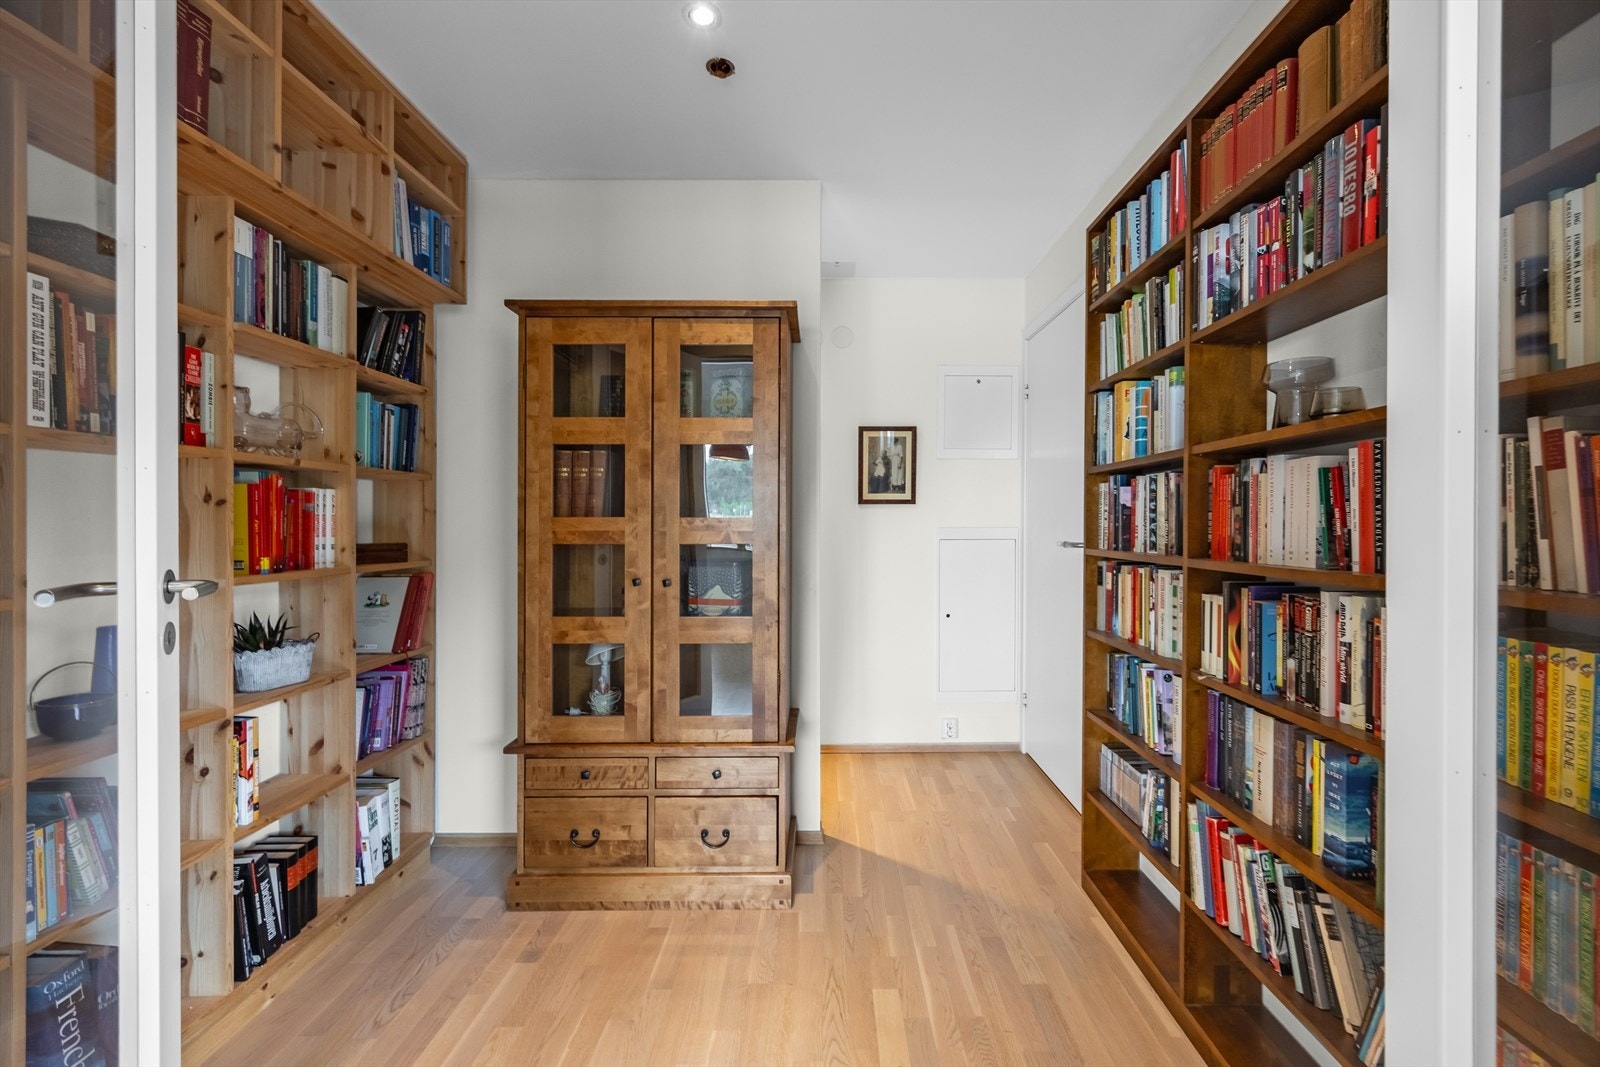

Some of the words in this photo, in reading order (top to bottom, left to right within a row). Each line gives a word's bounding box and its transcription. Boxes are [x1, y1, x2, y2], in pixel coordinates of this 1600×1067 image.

[1344, 141, 1357, 159] JO
[1343, 160, 1357, 218] NESBØ
[1573, 211, 1582, 226] DAG
[1573, 232, 1582, 259] FORSØK
[32, 293, 45, 312] ANY
[32, 311, 45, 331] GUN
[1573, 310, 1582, 324] DET
[32, 329, 45, 348] CAN
[32, 346, 45, 369] PLAY
[1374, 461, 1382, 500] WELDON
[1375, 504, 1383, 553] VRANGLÅS
[1340, 646, 1348, 661] Min
[1339, 661, 1347, 684] skyld
[1509, 662, 1518, 686] ONKEL
[1523, 666, 1533, 696] DONALD
[1536, 669, 1546, 696] ONKEL
[1552, 668, 1561, 698] DONALD
[1509, 686, 1517, 710] SKRUE
[1564, 683, 1578, 710] PASS
[1579, 687, 1592, 705] ER
[1522, 697, 1532, 720] DUCK
[1535, 696, 1545, 723] SKRUE
[1552, 698, 1560, 720] DUCK
[1564, 710, 1579, 724] PÅ
[1579, 704, 1592, 728] IKKE
[1509, 710, 1517, 740] JORDEN
[1522, 720, 1532, 734] OG
[1535, 723, 1545, 738] GIR
[1551, 720, 1560, 748] KLARER
[1508, 740, 1517, 767] RUNDT
[1534, 739, 1545, 757] SEG
[1563, 724, 1577, 770] PENGENE
[1577, 729, 1592, 784] SKVETTEN
[1534, 757, 1544, 777] IKKE
[44, 959, 85, 995] Oxford
[55, 982, 96, 1067] French
